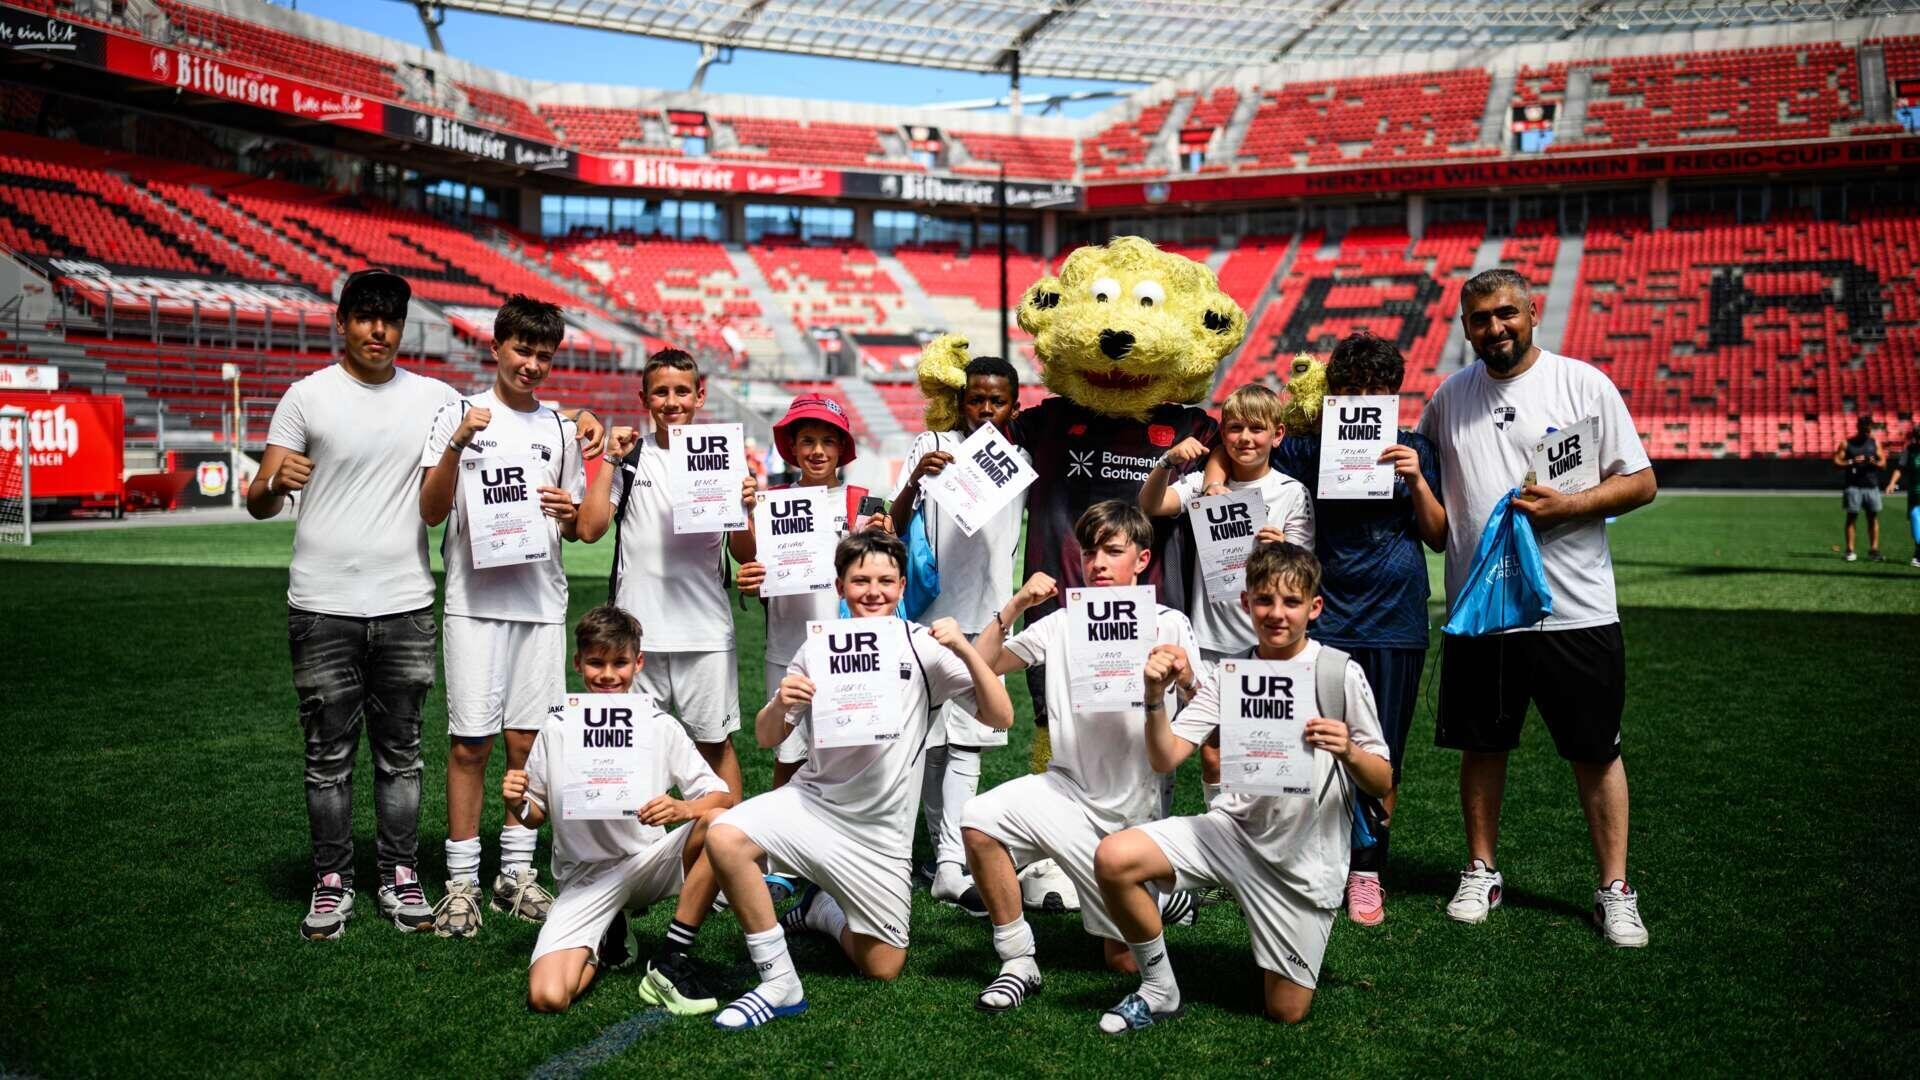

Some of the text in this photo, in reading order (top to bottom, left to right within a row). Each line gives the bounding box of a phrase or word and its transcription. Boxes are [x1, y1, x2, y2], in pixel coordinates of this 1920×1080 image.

[17, 26, 46, 41] ein
[47, 20, 77, 42] Bit
[176, 53, 280, 107] Bitburger
[431, 116, 507, 160] Bitburger
[633, 159, 735, 190] Bitburger
[1305, 166, 1436, 191] HERZLICH
[1443, 156, 1630, 184] WILLKOMMEN
[1674, 145, 1841, 170] REGIO-CUP
[902, 173, 995, 204] Bitburger
[1340, 407, 1382, 424] UR
[1338, 424, 1382, 441] KUNDE
[686, 435, 729, 454] UR
[1547, 433, 1582, 463] UR
[15, 452, 63, 466] KLSCH
[687, 454, 730, 472] KUNDE
[971, 448, 1010, 489] KUNDE
[984, 439, 1019, 481] UR
[1548, 450, 1583, 481] KUNDE
[481, 466, 527, 487] UR
[1100, 466, 1150, 482] Gothae
[483, 485, 528, 506] KUNDE
[770, 498, 814, 518] UR
[1205, 502, 1251, 524] UR
[771, 517, 815, 536] KUNDE
[1209, 520, 1255, 542] KUNDE
[1086, 600, 1138, 621] UR
[828, 631, 880, 654] UR
[1088, 621, 1138, 642] KUNDE
[829, 653, 881, 675] KUNDE
[1241, 674, 1294, 698] UR
[584, 707, 634, 728] UR
[1241, 698, 1294, 721] KUNDE
[583, 728, 634, 748] KUNDE
[1286, 954, 1309, 970] JAKO
